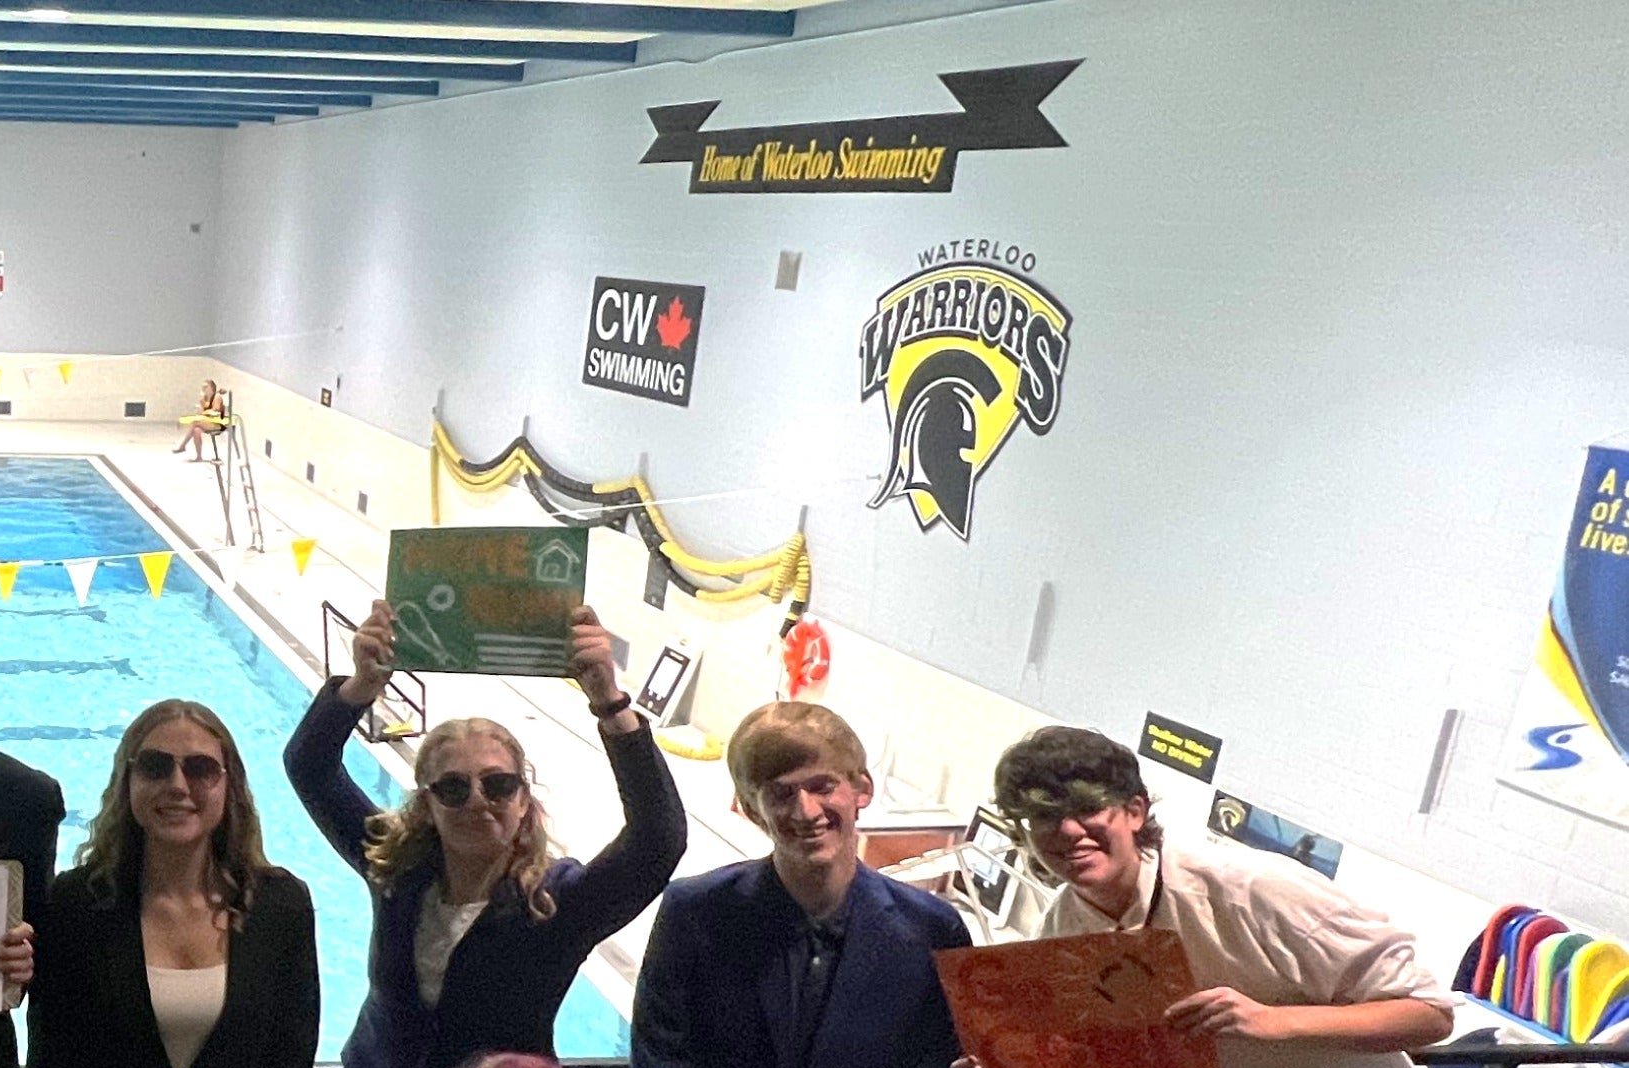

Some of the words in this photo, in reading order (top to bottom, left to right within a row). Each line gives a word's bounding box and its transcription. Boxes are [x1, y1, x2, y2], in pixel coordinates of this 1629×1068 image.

[699, 145, 740, 182] Home
[740, 143, 762, 181] of
[762, 139, 834, 181] Waterloo
[835, 134, 947, 184] Swimming
[917, 238, 1037, 273] WATERLOO
[595, 288, 658, 346] CW
[587, 347, 686, 397] SWIMMING
[860, 277, 1072, 436] WARRIORS
[1598, 468, 1616, 495] A
[1590, 498, 1623, 524] of
[1579, 522, 1629, 555] live
[1151, 739, 1168, 754] NO
[1167, 745, 1203, 769] DIVING
